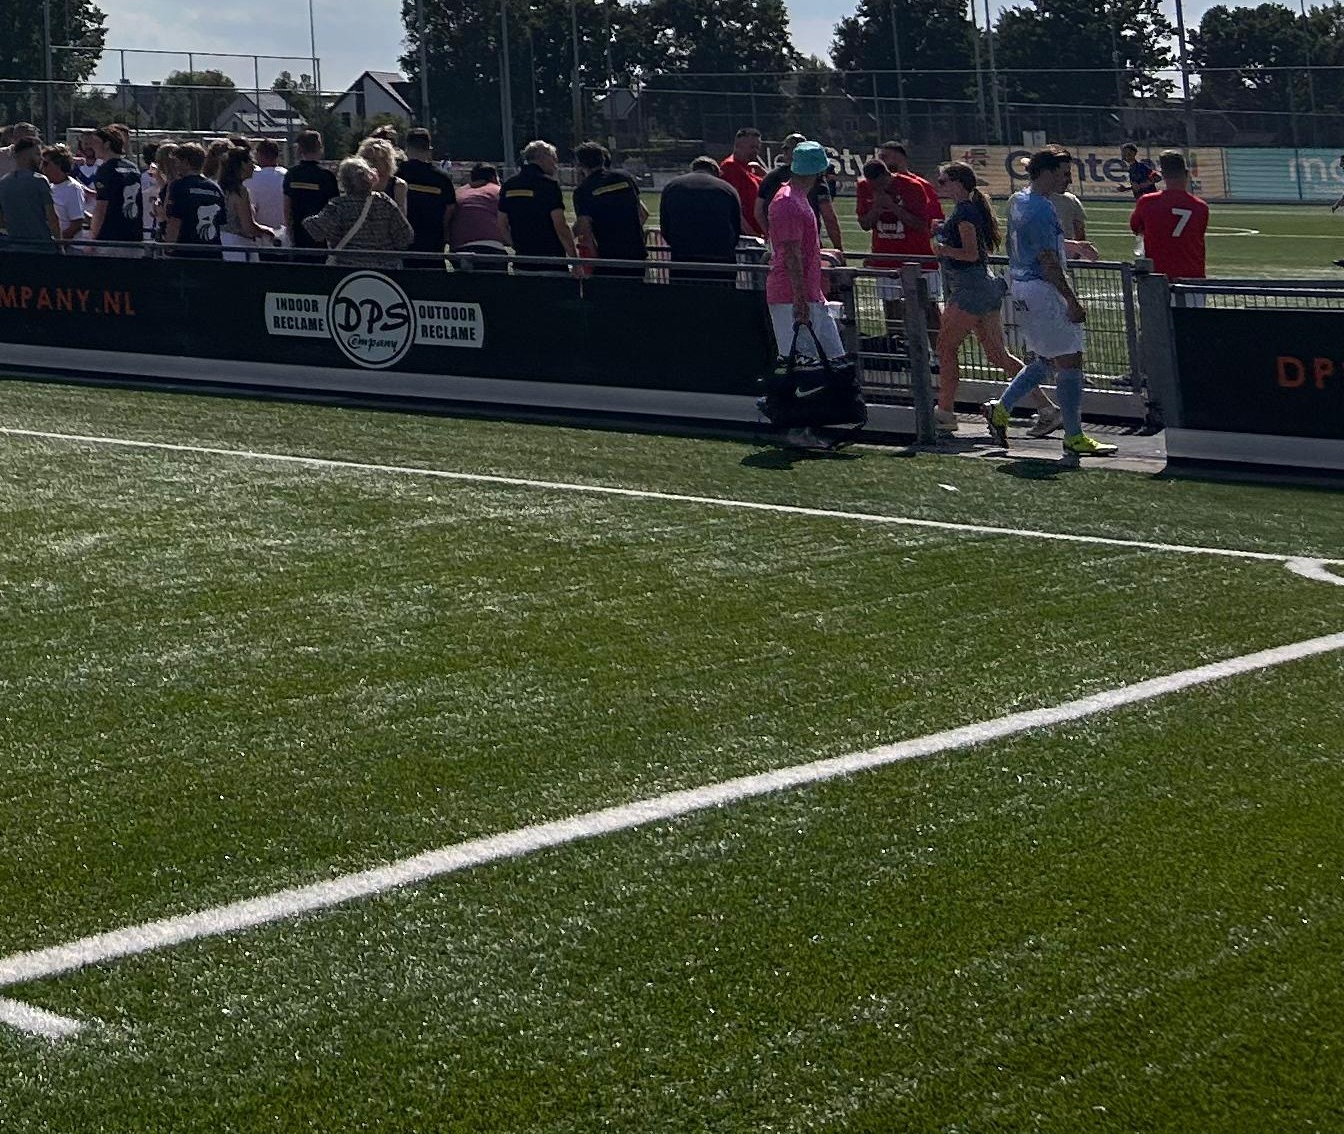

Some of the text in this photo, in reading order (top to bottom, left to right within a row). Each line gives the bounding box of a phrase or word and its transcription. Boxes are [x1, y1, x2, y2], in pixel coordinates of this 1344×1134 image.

[1171, 207, 1193, 237] 7
[276, 297, 319, 313] INDOOR
[419, 305, 476, 322] OUTDOOR
[273, 315, 324, 332] RECLAME
[334, 297, 411, 334] DPS
[421, 325, 476, 341] RECLAME
